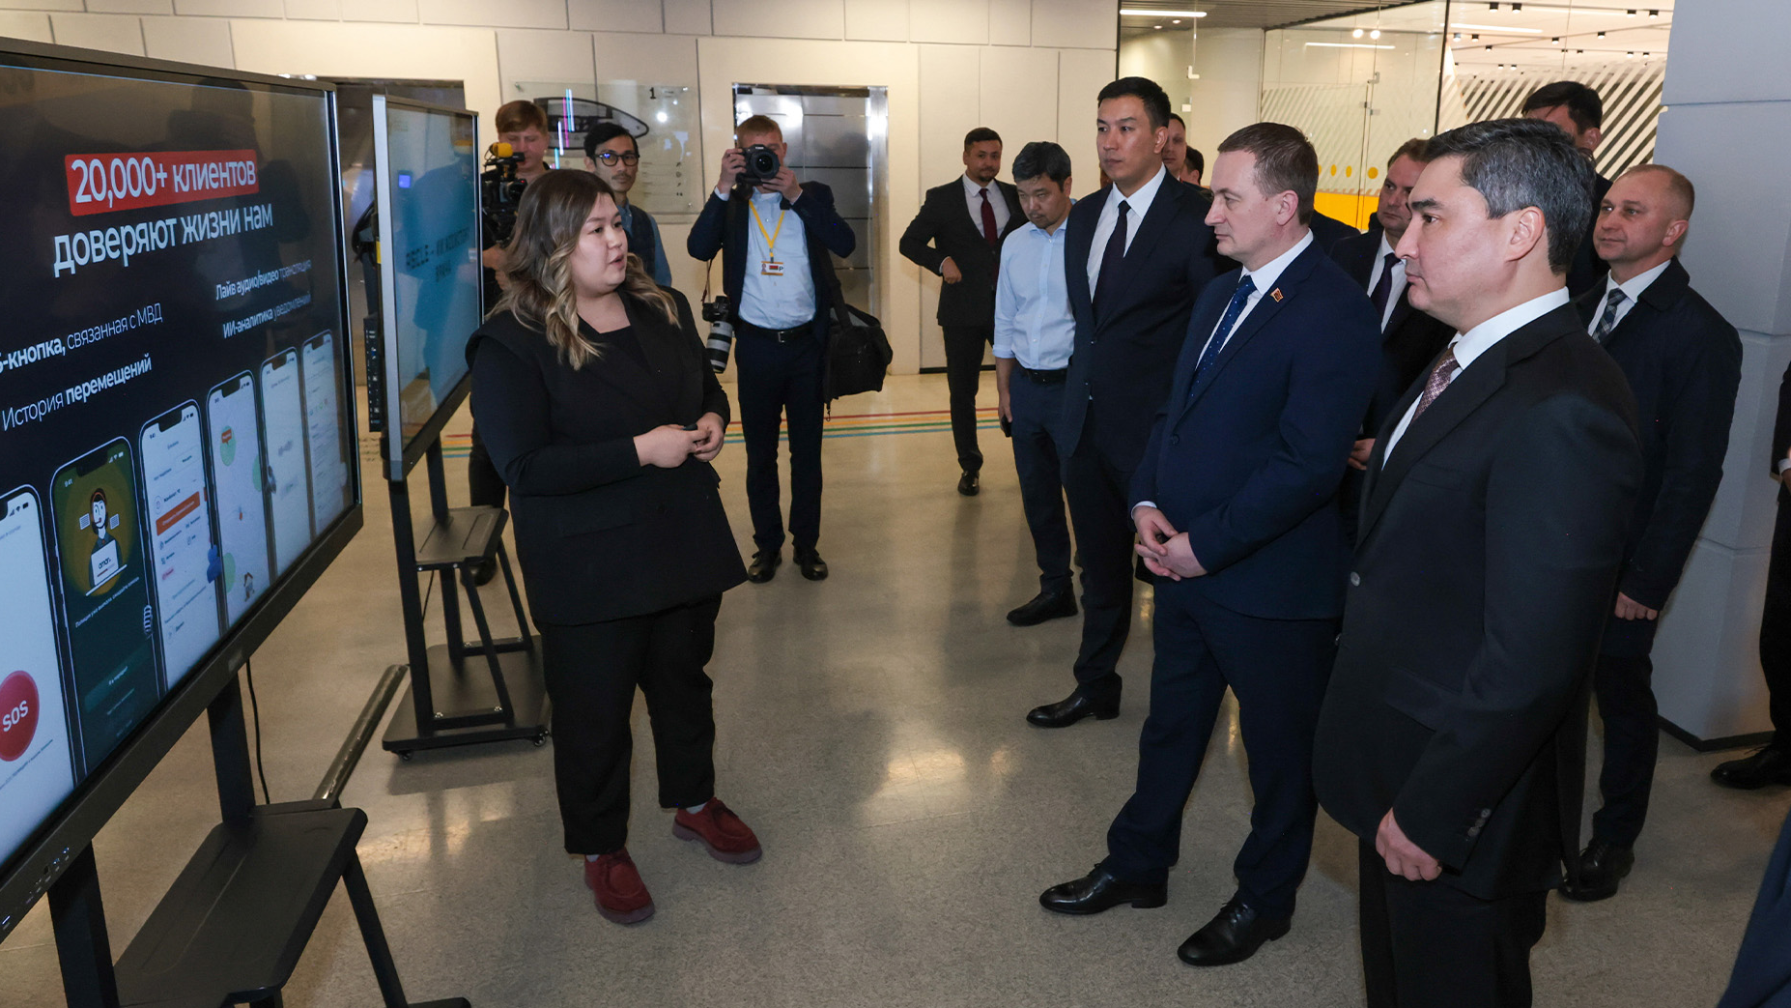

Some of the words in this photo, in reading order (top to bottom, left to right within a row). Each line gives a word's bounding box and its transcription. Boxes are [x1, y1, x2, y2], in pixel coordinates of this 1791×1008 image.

[649, 87, 656, 99] 1
[71, 157, 168, 208] 20,000+
[173, 160, 256, 193] клиентов
[53, 218, 177, 278] доверяют
[180, 210, 241, 244] жизни
[243, 203, 273, 232] нам
[216, 280, 236, 300] Лайв
[66, 317, 129, 350] связанная
[129, 314, 136, 329] с
[136, 302, 163, 327] МВД
[223, 308, 274, 339] ИИ-аналитика
[1, 392, 64, 431] История
[65, 353, 152, 405] перемещений
[2, 700, 29, 732] SOS
